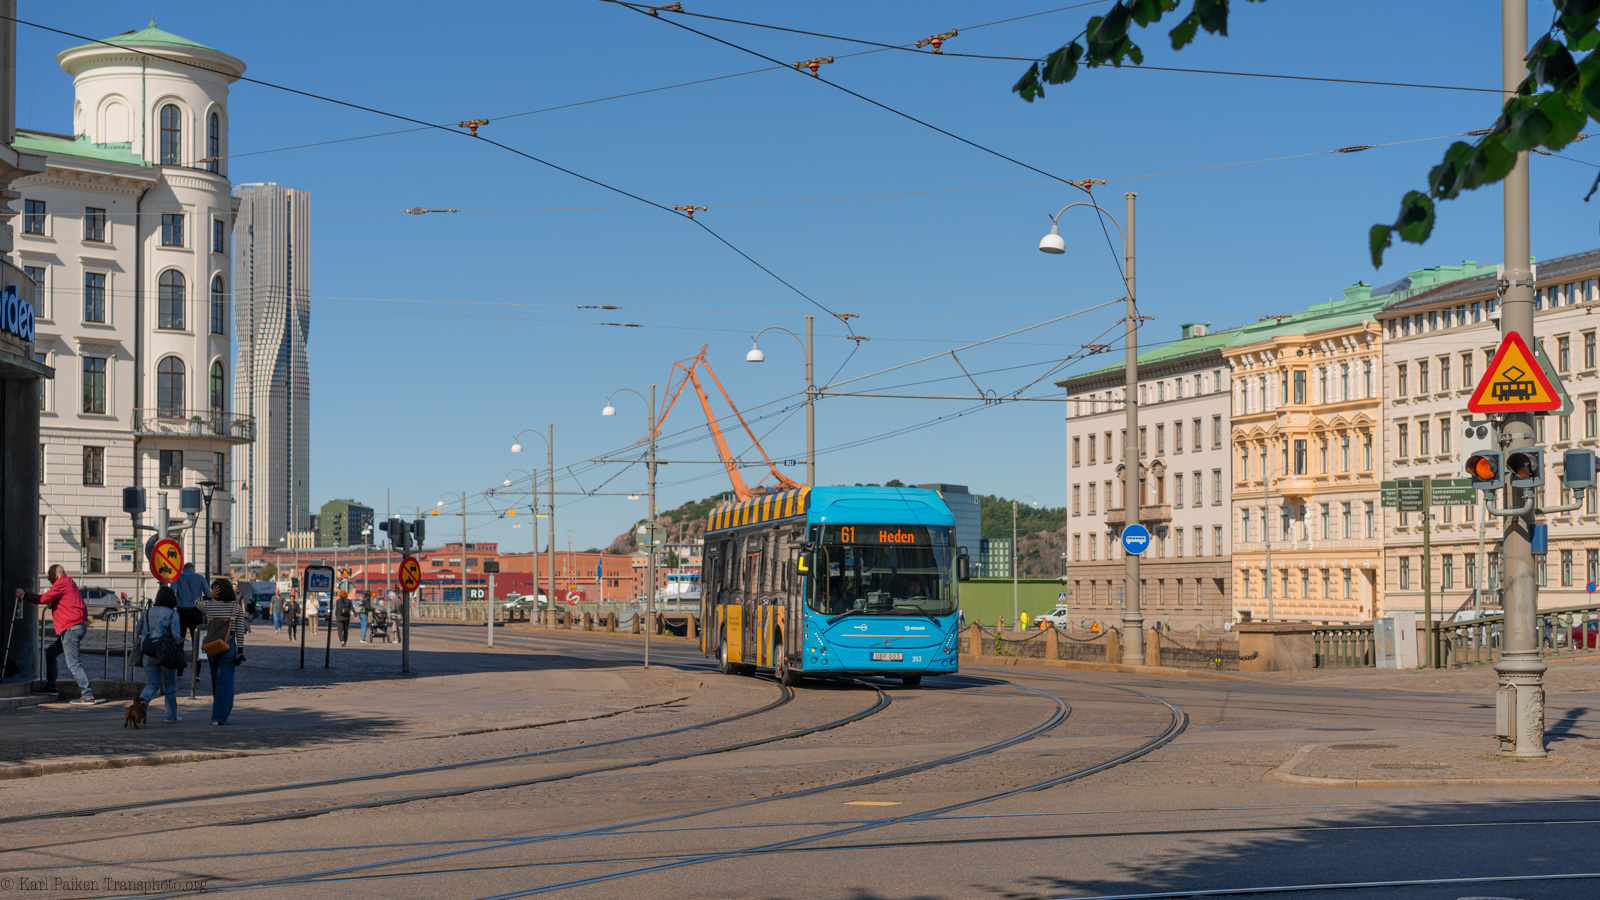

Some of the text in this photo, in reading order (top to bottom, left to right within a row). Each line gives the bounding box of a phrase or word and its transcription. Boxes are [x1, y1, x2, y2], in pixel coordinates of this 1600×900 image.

[0, 286, 34, 342] rdea
[841, 526, 915, 544] 61 Heden
[470, 589, 485, 598] RD
